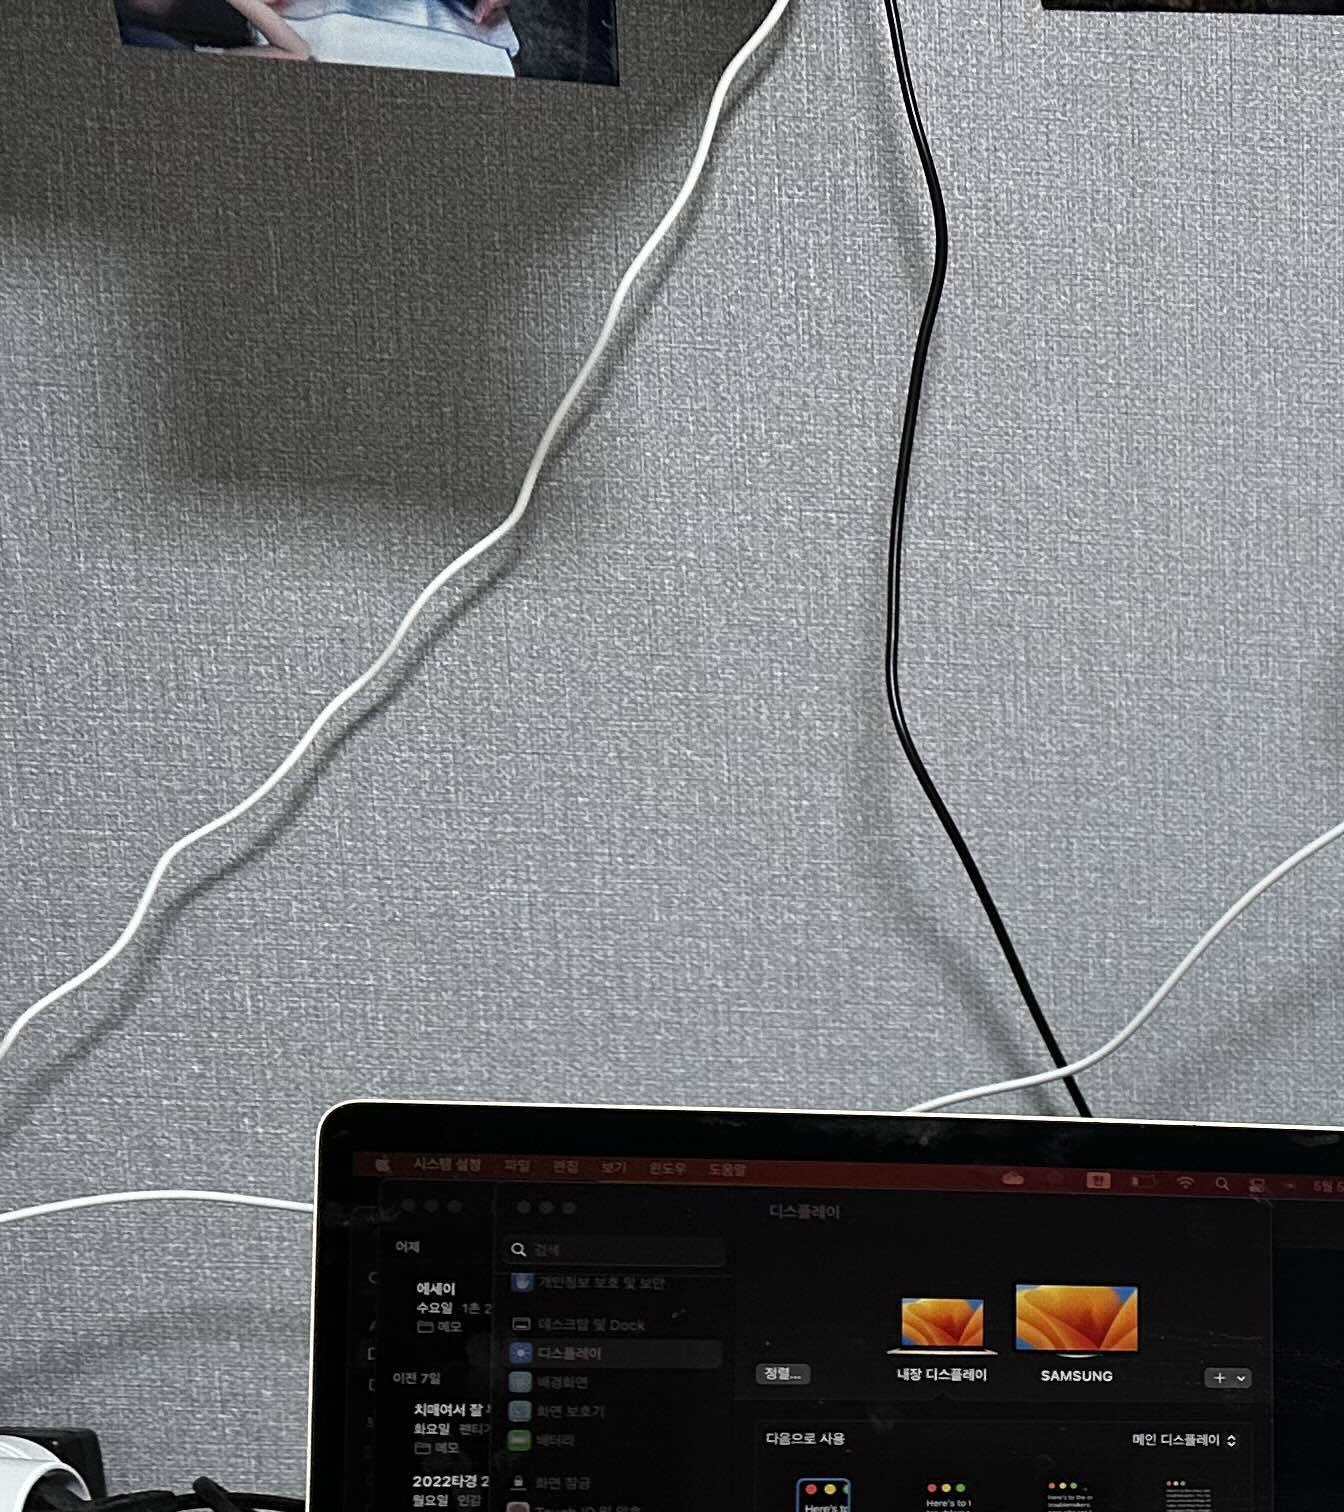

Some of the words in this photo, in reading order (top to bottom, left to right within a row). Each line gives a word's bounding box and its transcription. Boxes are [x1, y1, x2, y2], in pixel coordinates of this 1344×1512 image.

[768, 1203, 840, 1221] 디스플레이
[394, 1240, 420, 1255] 어제
[416, 1280, 456, 1296] 에세이
[416, 1301, 453, 1315] 수요일
[437, 1320, 463, 1334] 메모
[609, 1318, 646, 1332] Dock
[536, 1346, 602, 1361] 디스플레이
[392, 1372, 417, 1386] 이전
[420, 1372, 441, 1386] 7일
[897, 1367, 922, 1382] 내장
[926, 1368, 987, 1383] 디스플레이
[1040, 1369, 1113, 1383] SAMSUNG
[470, 1402, 484, 1418] 잘
[413, 1422, 450, 1436] 화요일
[766, 1432, 816, 1446] 다음으로
[820, 1432, 846, 1446] 사용
[1132, 1432, 1157, 1447] 메인
[1161, 1433, 1221, 1447] 디스플레이
[434, 1441, 461, 1456] 메모
[411, 1493, 448, 1508] 월요일
